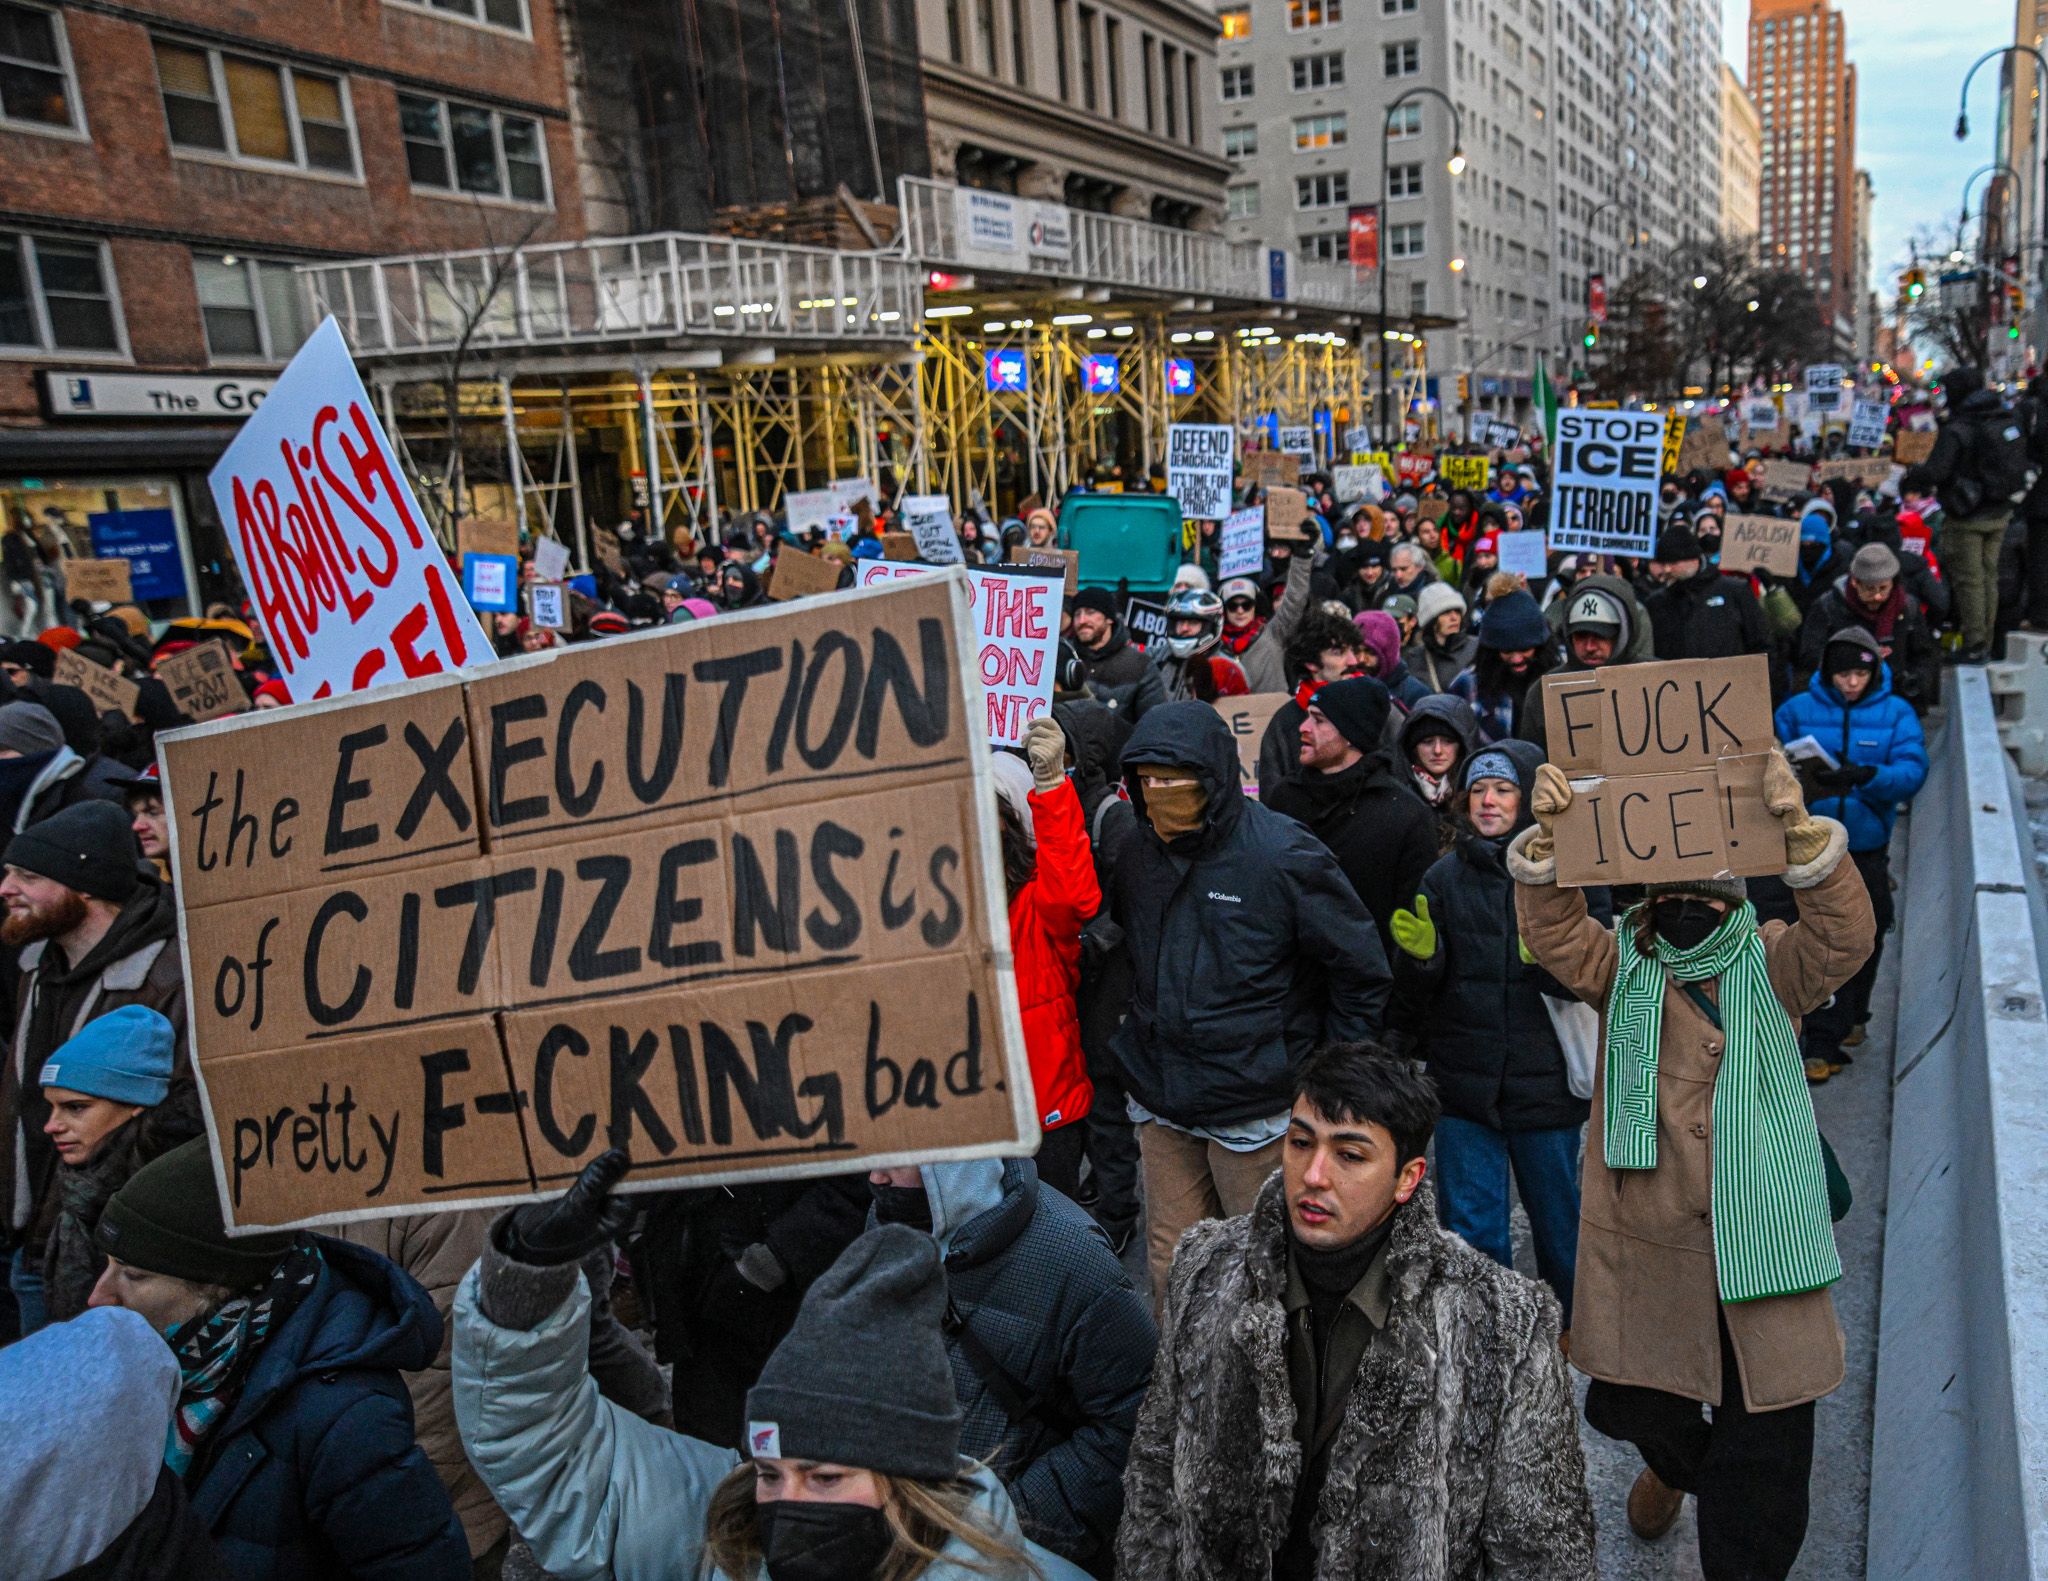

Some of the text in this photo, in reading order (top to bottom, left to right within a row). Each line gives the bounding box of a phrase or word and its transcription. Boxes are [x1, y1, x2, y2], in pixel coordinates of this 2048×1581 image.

[146, 383, 268, 412] The Go
[1172, 429, 1229, 454] DEFEND
[1560, 416, 1659, 443] STOP
[1284, 439, 1309, 449] ICE
[1171, 454, 1229, 470] DEMOCRACY:
[1560, 441, 1658, 480] ICE
[1171, 473, 1230, 489] IT'S TIME FOR
[1177, 487, 1223, 503] A GENERAL
[1183, 501, 1216, 516] STRIKE!
[1558, 484, 1653, 536] TERROR
[232, 401, 424, 674] ABOLISH
[1554, 533, 1564, 545] ICE
[1565, 533, 1579, 546] OUT
[1734, 521, 1795, 546] ABOLISH
[1029, 552, 1067, 566] ABOLISH
[1746, 544, 1772, 563] ICE
[981, 577, 1048, 640] THE
[1582, 598, 1598, 616] NY
[1132, 609, 1167, 636] ABO
[978, 643, 1045, 687] ON
[1232, 712, 1254, 734] E
[1560, 680, 1742, 757] FUCK
[192, 617, 950, 872] the EXECUTION
[1588, 785, 1739, 865] ICE!
[1214, 893, 1242, 902] Columbia
[215, 819, 963, 1032] of CITIZENS is
[233, 991, 1006, 1207] pretty F-CKING bad.
